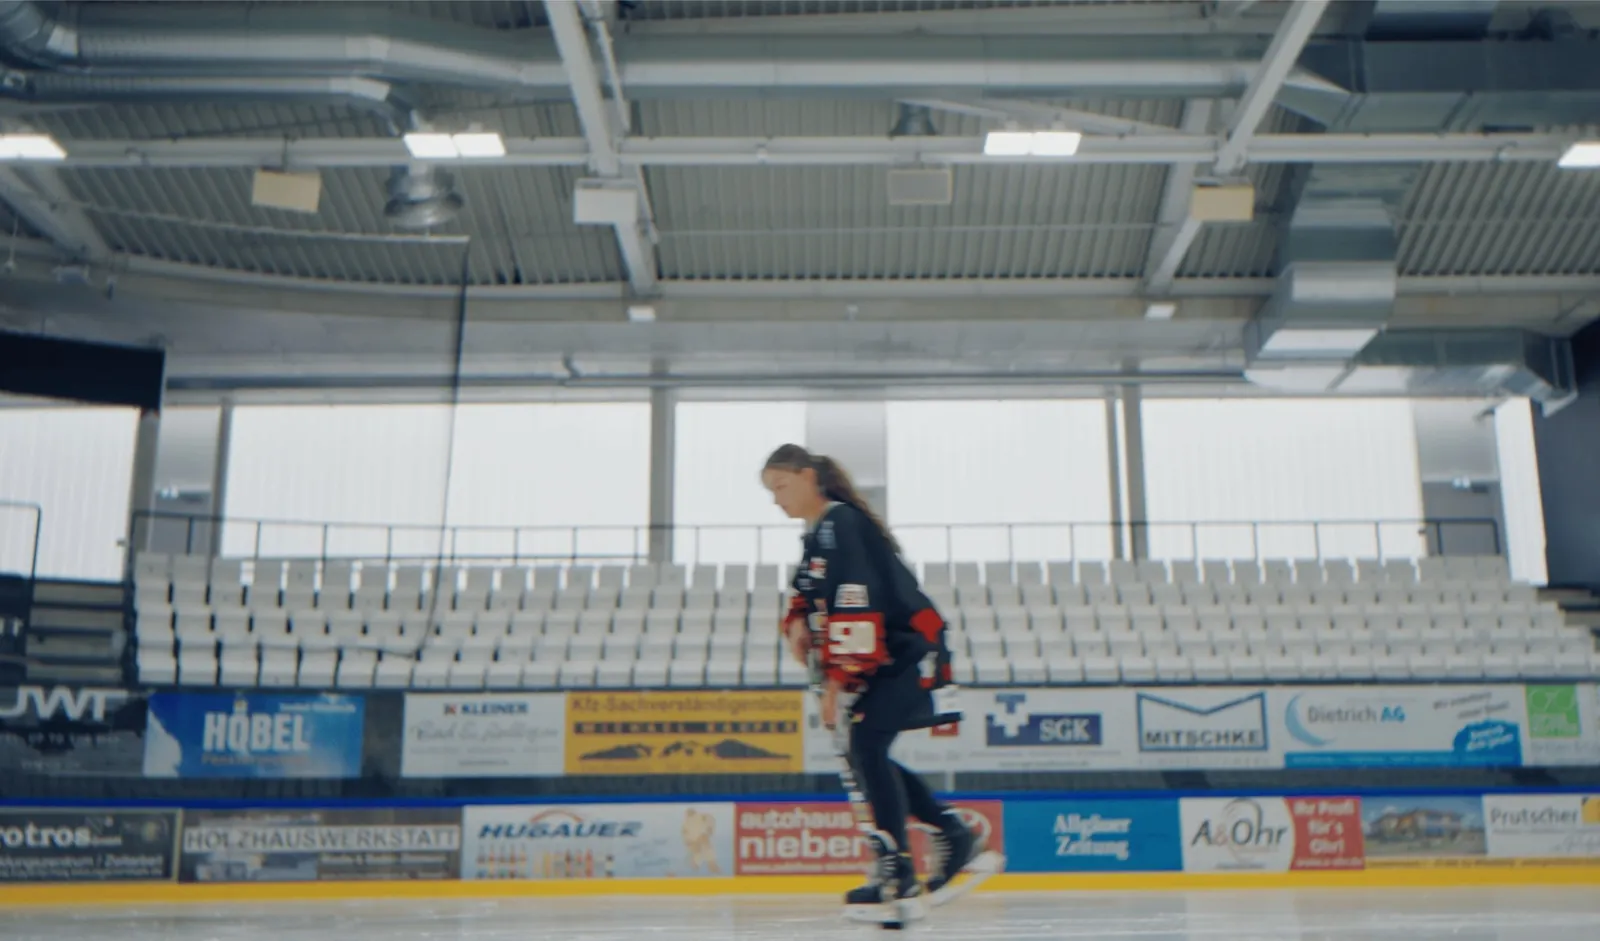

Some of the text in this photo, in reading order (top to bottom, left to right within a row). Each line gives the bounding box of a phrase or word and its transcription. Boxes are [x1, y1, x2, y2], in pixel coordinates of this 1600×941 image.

[1307, 704, 1407, 723] Dietrich AG
[1039, 717, 1091, 742] SGK
[1146, 730, 1259, 745] MITSCHKE
[740, 808, 854, 830] autohaus
[1490, 807, 1579, 825] Prutscher
[185, 827, 458, 850] HOLZHAUSWERKSTATT
[479, 821, 643, 838] HUGAUER
